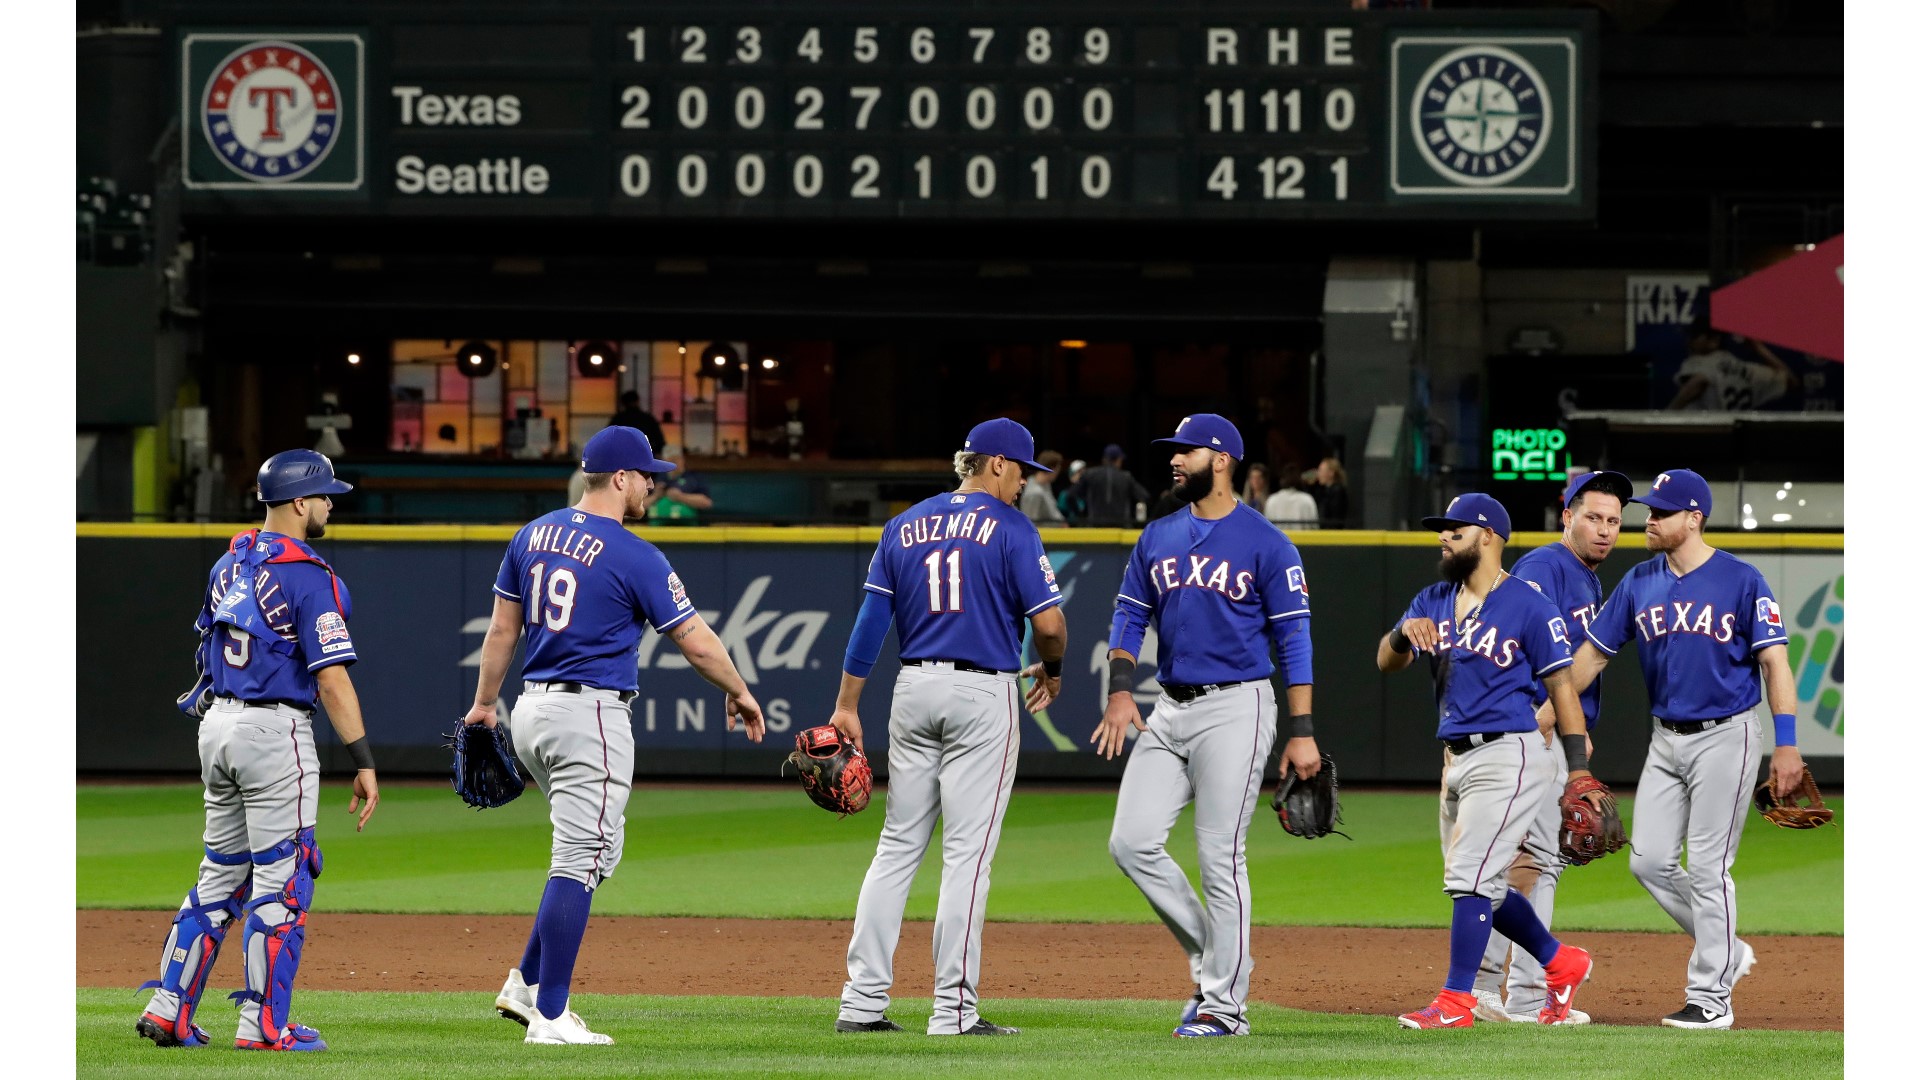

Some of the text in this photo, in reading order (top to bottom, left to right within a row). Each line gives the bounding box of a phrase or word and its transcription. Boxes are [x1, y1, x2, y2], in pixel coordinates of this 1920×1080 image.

[222, 47, 320, 85] TEXAS
[628, 27, 1353, 65] 1 2 3 4 5 6 7 8 9 R H E
[1427, 57, 1537, 103] SEATTLE
[392, 86, 1355, 132] Texas 2 0 0 2 7 0 0 0 0 11 11 0
[212, 119, 332, 176] RANGERS
[1427, 127, 1538, 174] MARINERS
[396, 154, 1348, 200] Seattle 0 0 0 0 2 1 0 1 0 4 12 1
[1636, 284, 1697, 325] KAZ
[1492, 429, 1567, 451] PHOTO
[1652, 473, 1670, 490] T
[528, 525, 604, 567] MILLER
[900, 505, 998, 548] GUZMÁN
[529, 560, 578, 634] 19
[924, 548, 963, 614] 11
[1149, 555, 1255, 602] TEXAS
[1437, 617, 1520, 669] EXAS
[1634, 601, 1737, 643] TEXAS
